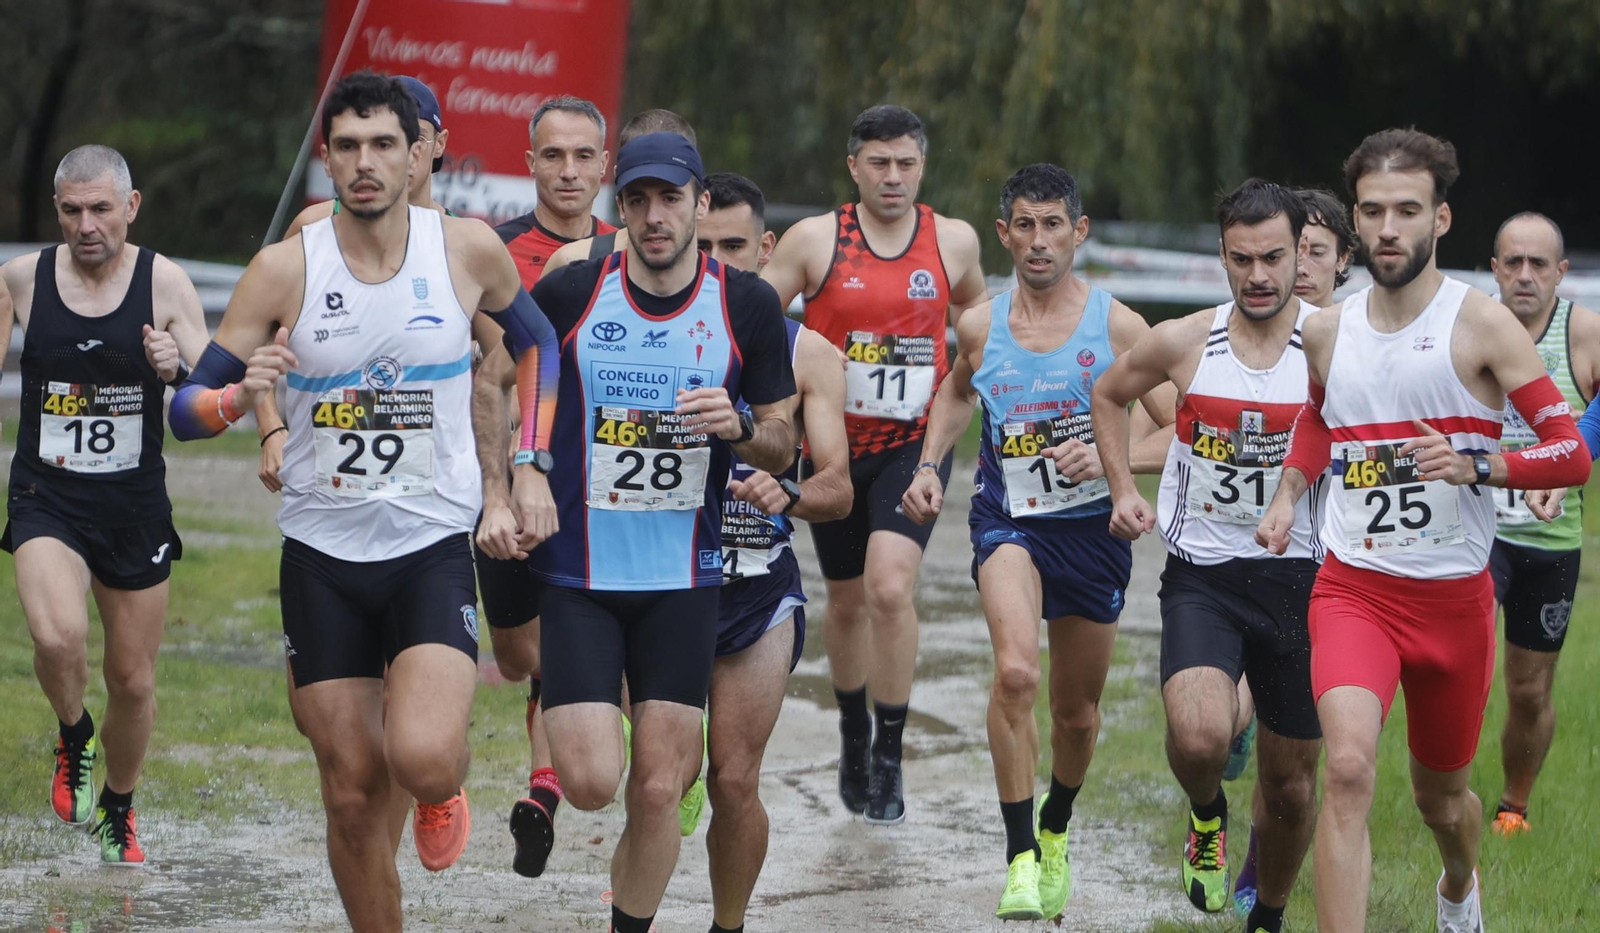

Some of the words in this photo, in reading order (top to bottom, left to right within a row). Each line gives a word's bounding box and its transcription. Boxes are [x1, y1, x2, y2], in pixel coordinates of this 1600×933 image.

[470, 40, 558, 77] nunha
[588, 342, 626, 352] NIPOCAR
[905, 354, 933, 362] ALONSO
[598, 369, 669, 385] CONCELLO
[98, 385, 143, 395] MEMORIAL
[867, 368, 906, 401] 11
[94, 393, 143, 404] BELARMINO
[378, 393, 433, 404] MEMORIAL
[606, 385, 624, 397] DE
[627, 387, 660, 400] VIGO
[108, 403, 142, 413] ALONSO
[373, 403, 433, 414] BELARMINO
[1014, 401, 1059, 413] ATLETISMO
[1061, 398, 1079, 409] SAR
[390, 414, 432, 425] ALONSO
[63, 419, 116, 455] 18
[671, 433, 708, 444] ALONSO
[1242, 441, 1288, 453] BELARMIN
[336, 432, 405, 476] 29
[613, 450, 683, 491] 28
[1211, 464, 1265, 506] 31
[1365, 485, 1432, 534] 25
[734, 536, 771, 546] ALONSO
